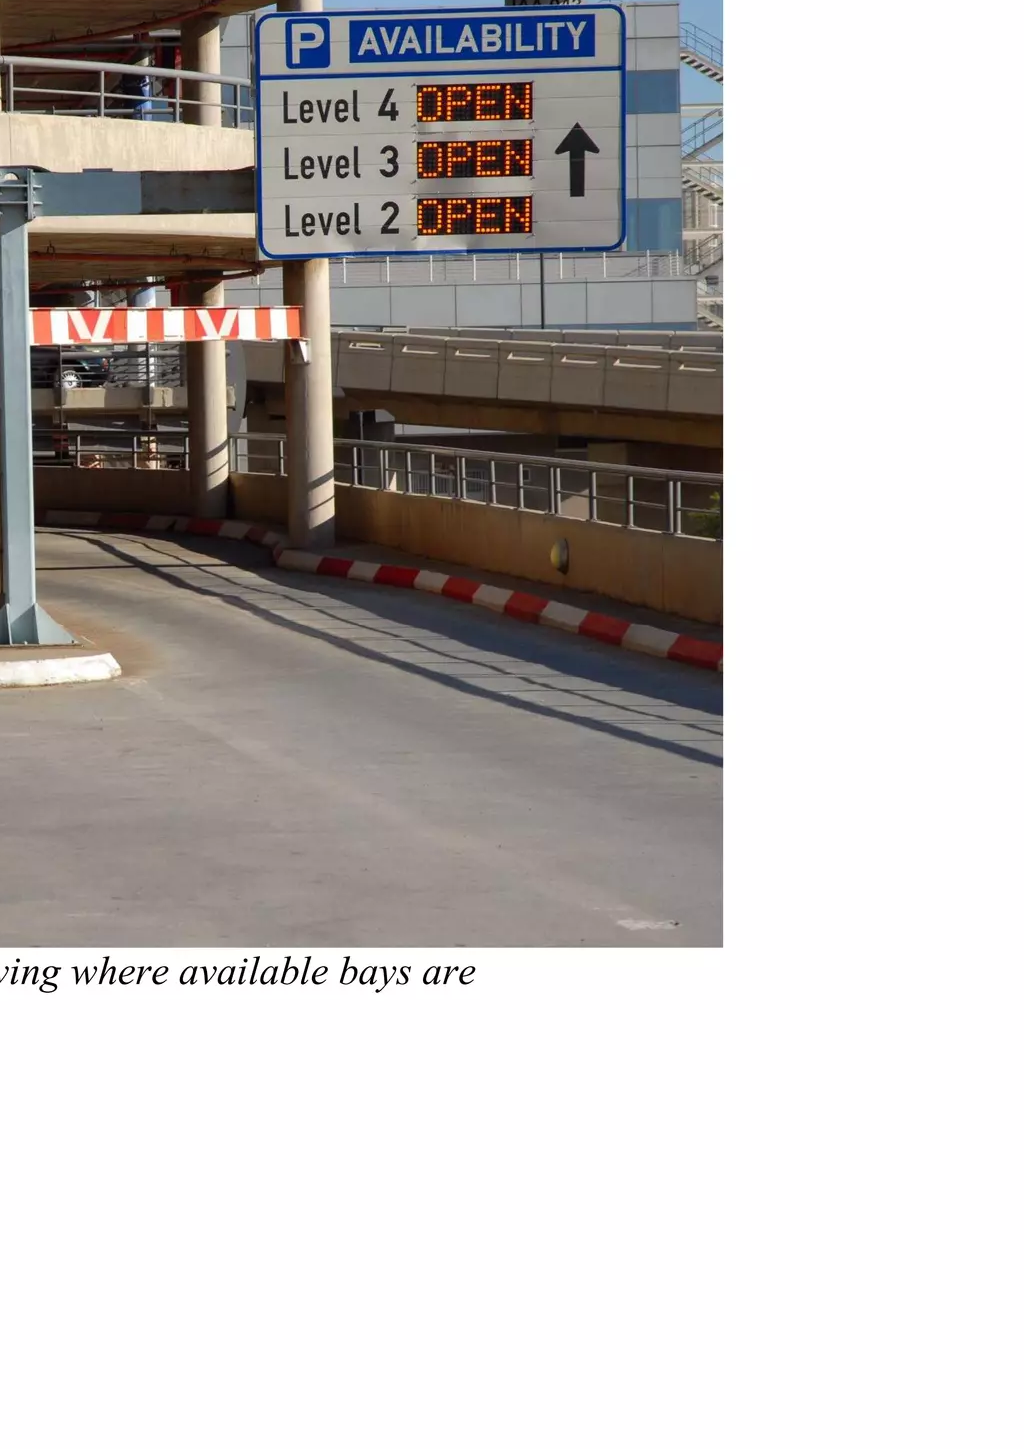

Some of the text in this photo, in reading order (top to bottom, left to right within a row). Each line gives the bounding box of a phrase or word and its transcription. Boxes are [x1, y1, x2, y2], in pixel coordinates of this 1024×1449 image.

[292, 22, 586, 63] P AVAILABILITY
[283, 84, 531, 124] Level 4 OPEN
[284, 141, 531, 180] Level 3 OPEN
[285, 198, 531, 237] Level 2 OPEN
